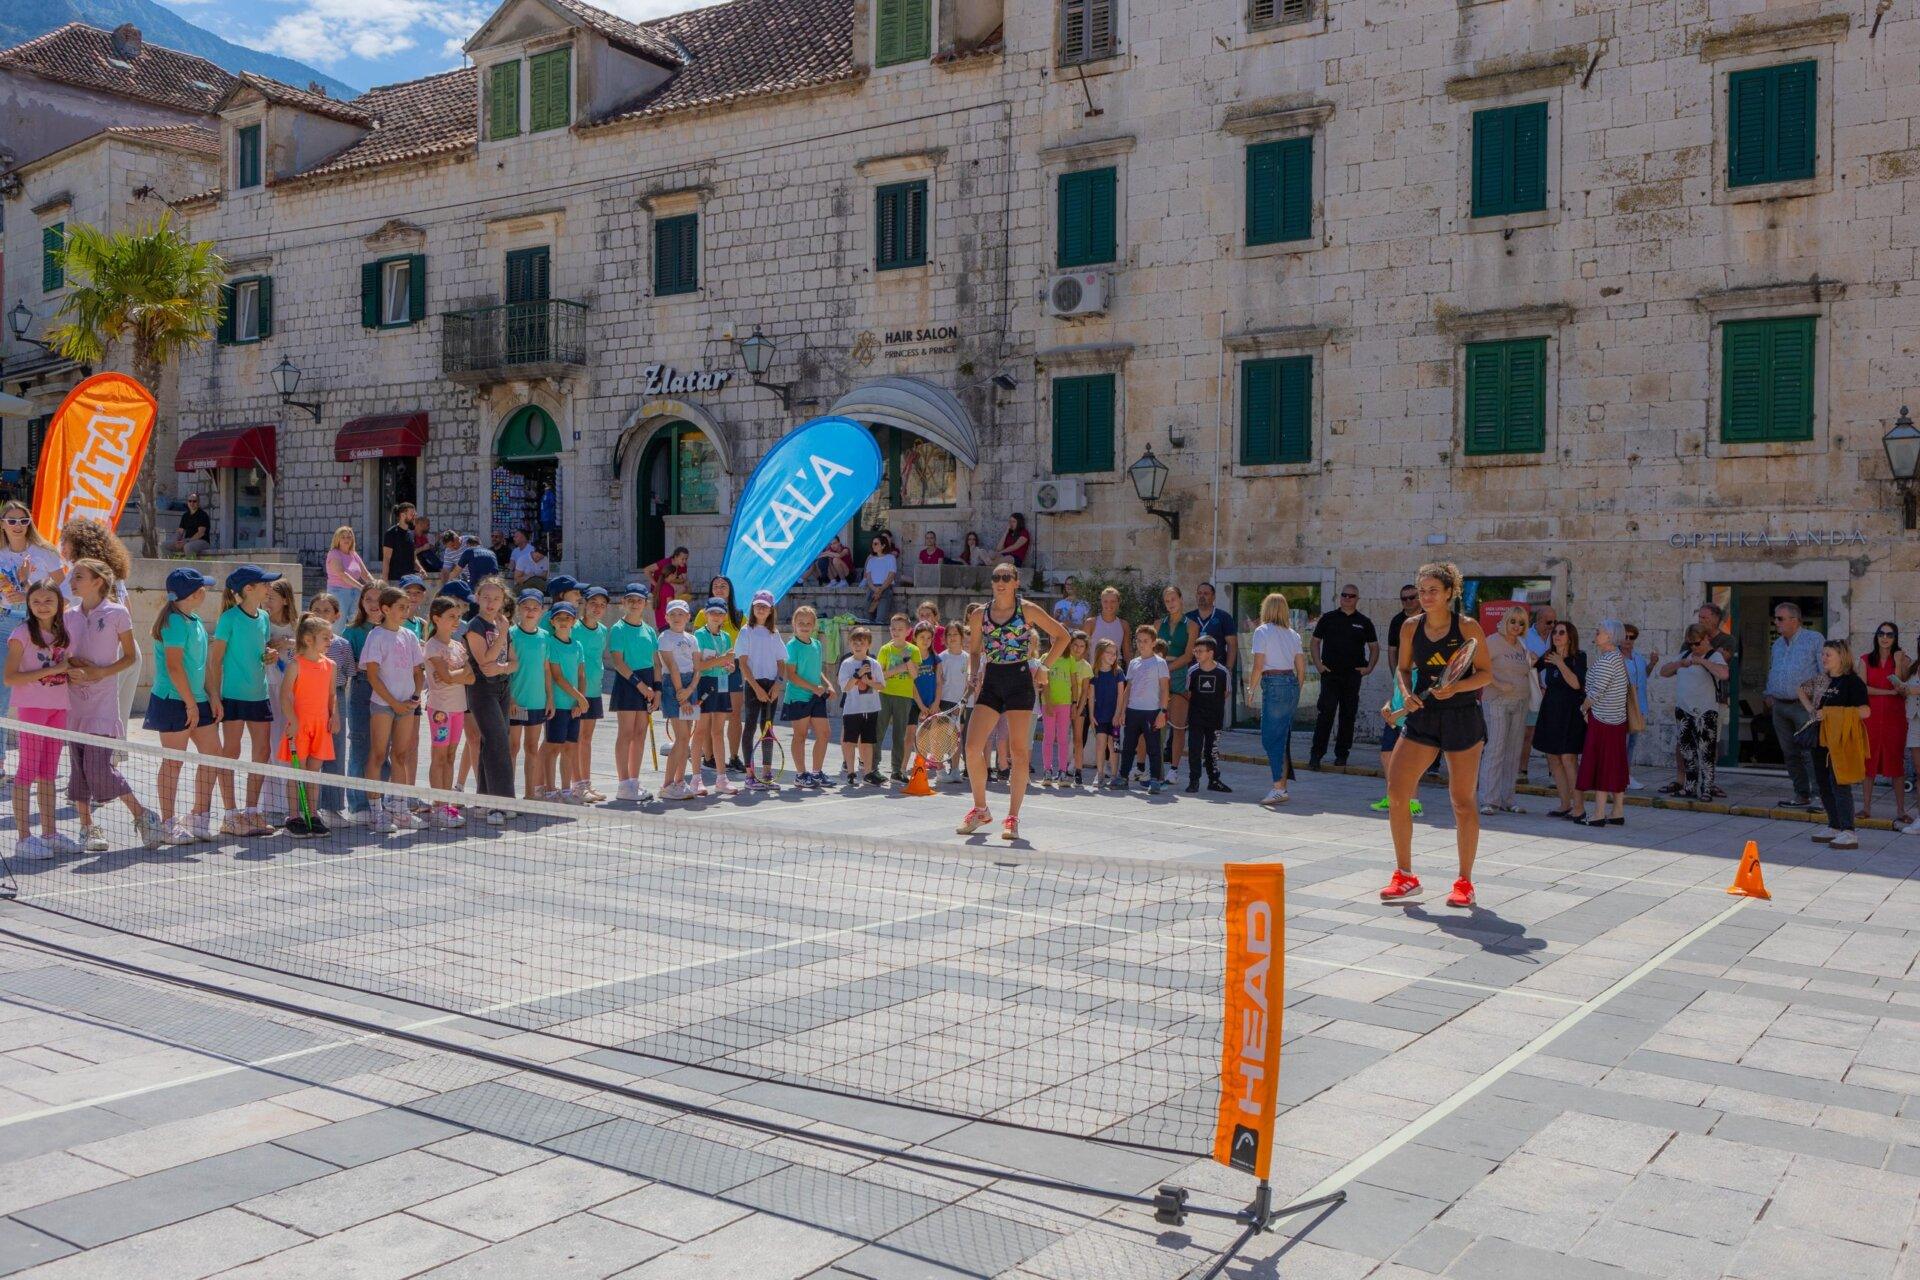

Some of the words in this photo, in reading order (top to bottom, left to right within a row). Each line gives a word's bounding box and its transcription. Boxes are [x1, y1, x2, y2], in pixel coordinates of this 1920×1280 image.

[885, 330, 913, 344] HAIR
[916, 326, 957, 341] SALON
[885, 348, 919, 359] PRINCESS
[921, 348, 927, 356] &
[929, 345, 957, 356] PRINCE
[643, 364, 729, 396] Zlatar
[1669, 530, 1770, 548] OPTIKA
[1785, 528, 1867, 547] ANDA
[1238, 900, 1271, 1116] HEAD
